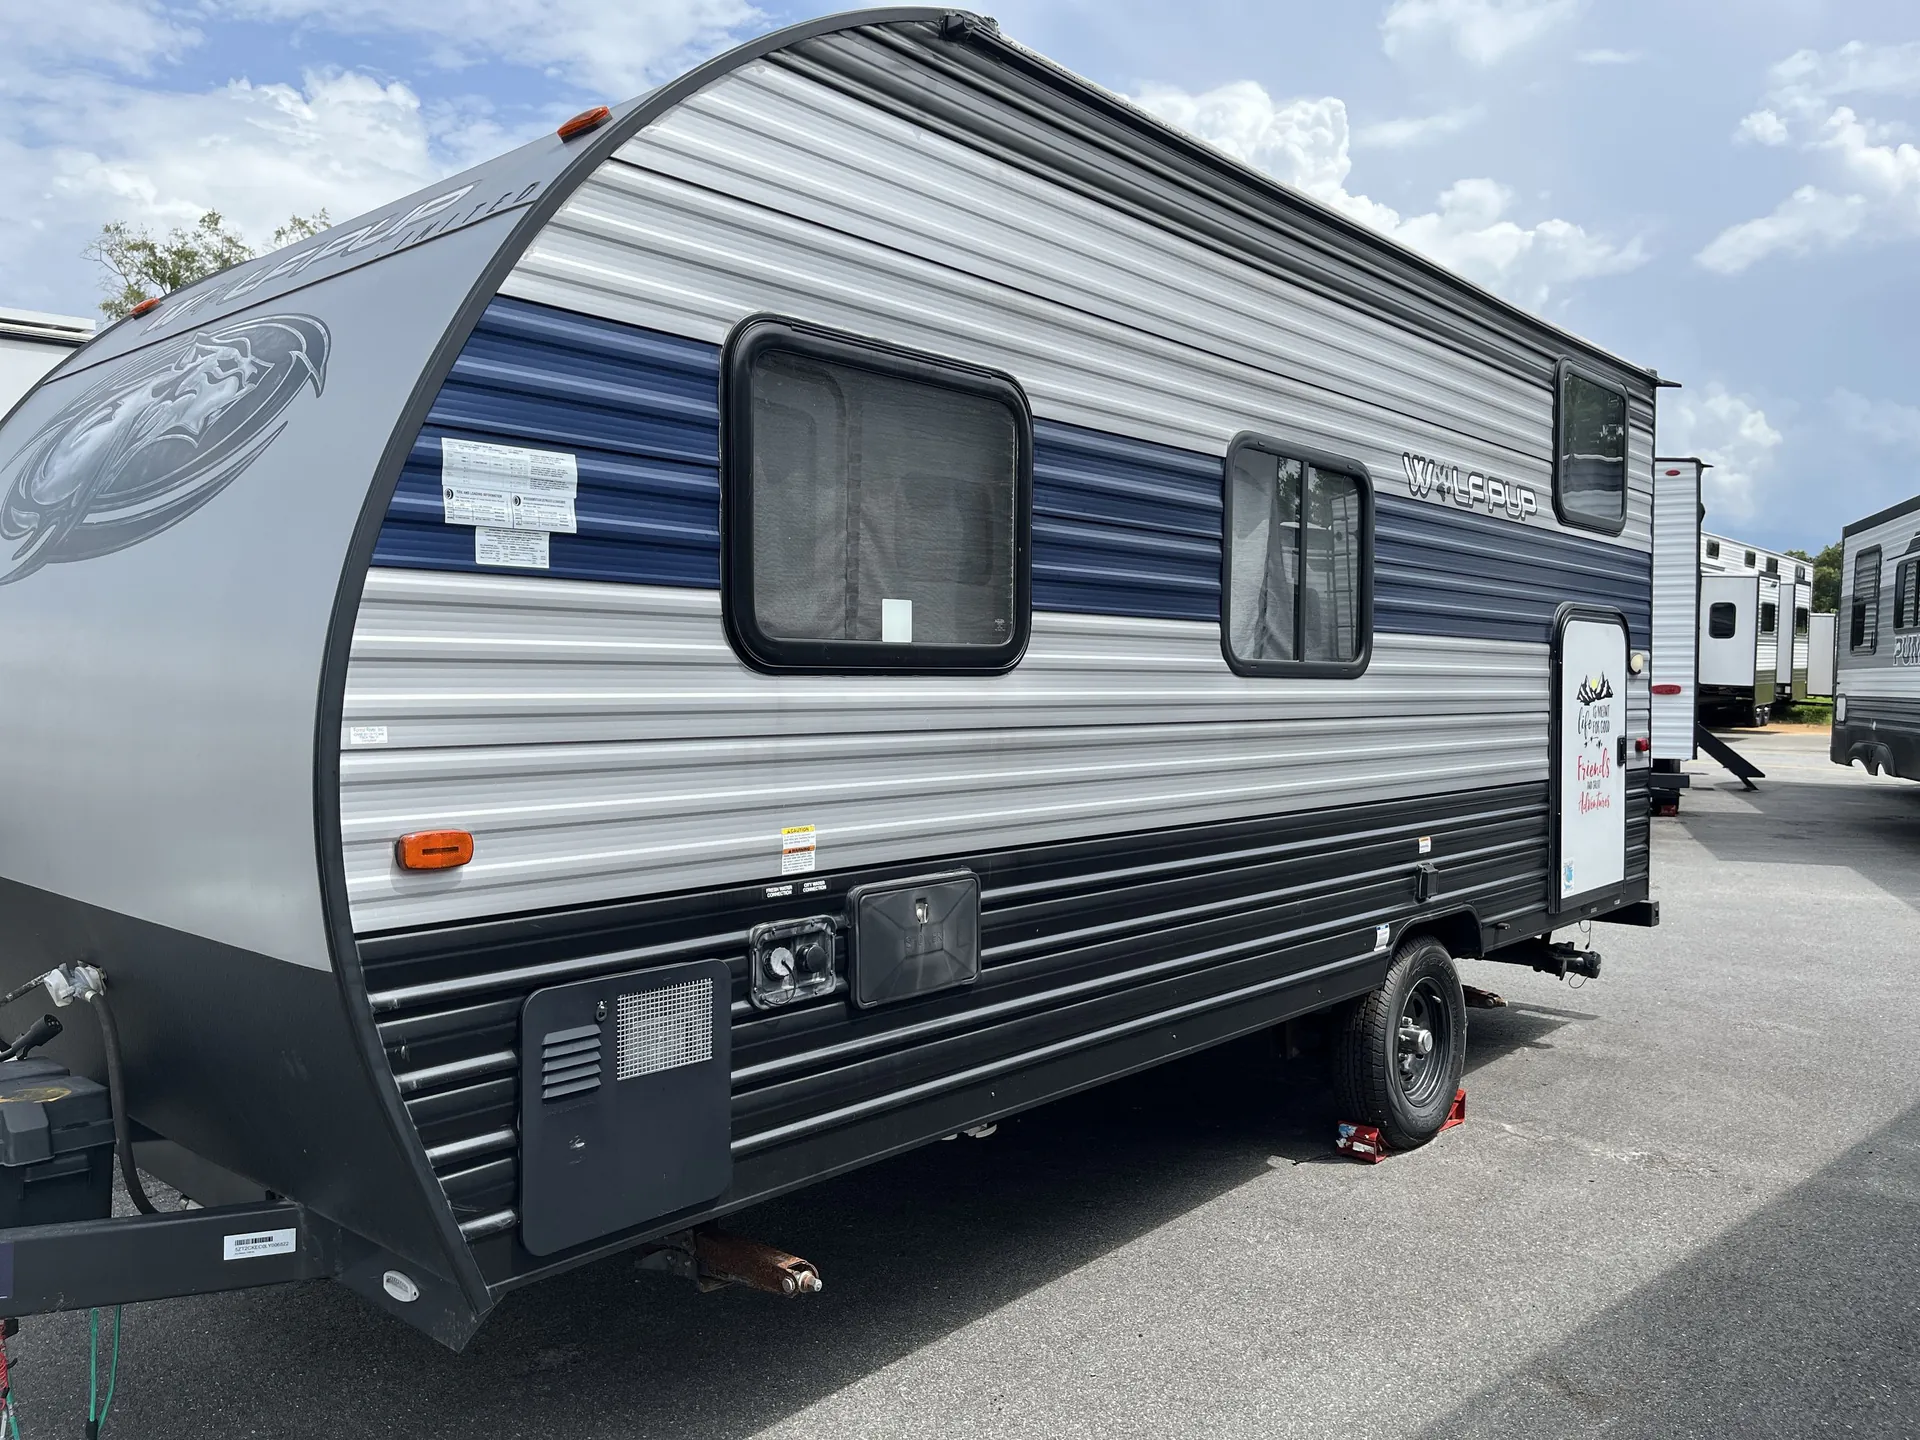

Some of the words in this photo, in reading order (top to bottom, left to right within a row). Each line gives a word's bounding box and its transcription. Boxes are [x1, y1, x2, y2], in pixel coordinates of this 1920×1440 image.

[1577, 747, 1610, 781] Friends
[791, 826, 809, 834] CAUTION
[802, 884, 827, 893] CONNECTION
[766, 889, 793, 898] CONNECTION
